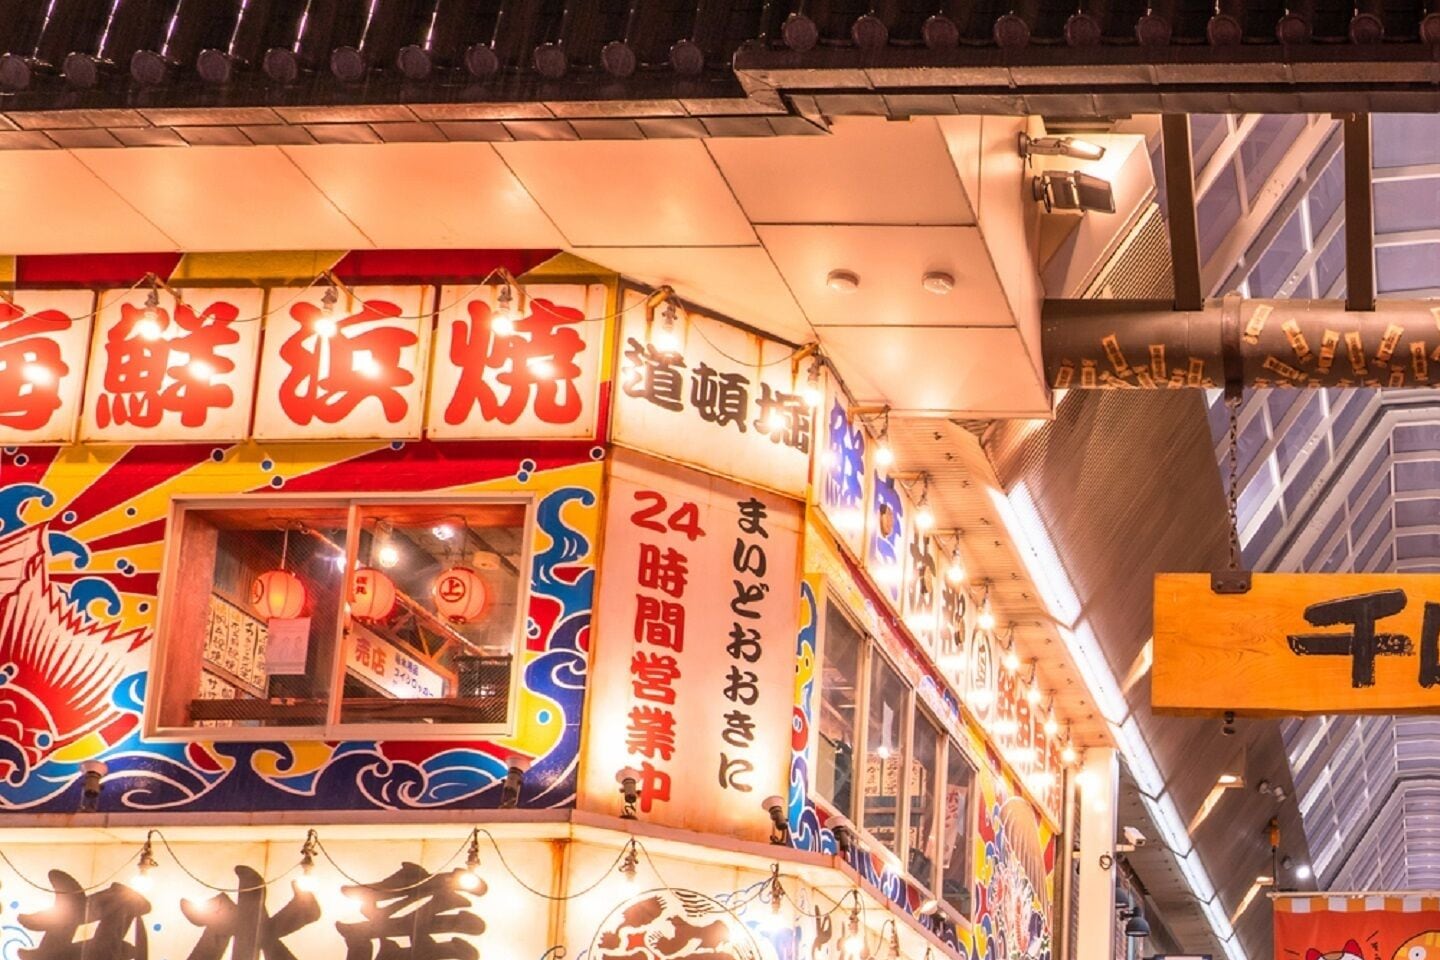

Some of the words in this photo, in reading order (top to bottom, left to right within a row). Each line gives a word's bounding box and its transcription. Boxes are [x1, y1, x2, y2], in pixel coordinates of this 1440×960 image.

[621, 337, 811, 454] 道頓堀
[356, 638, 387, 676] 売店
[625, 490, 706, 813] 24時間営業中
[718, 497, 769, 793] まいどおおきに
